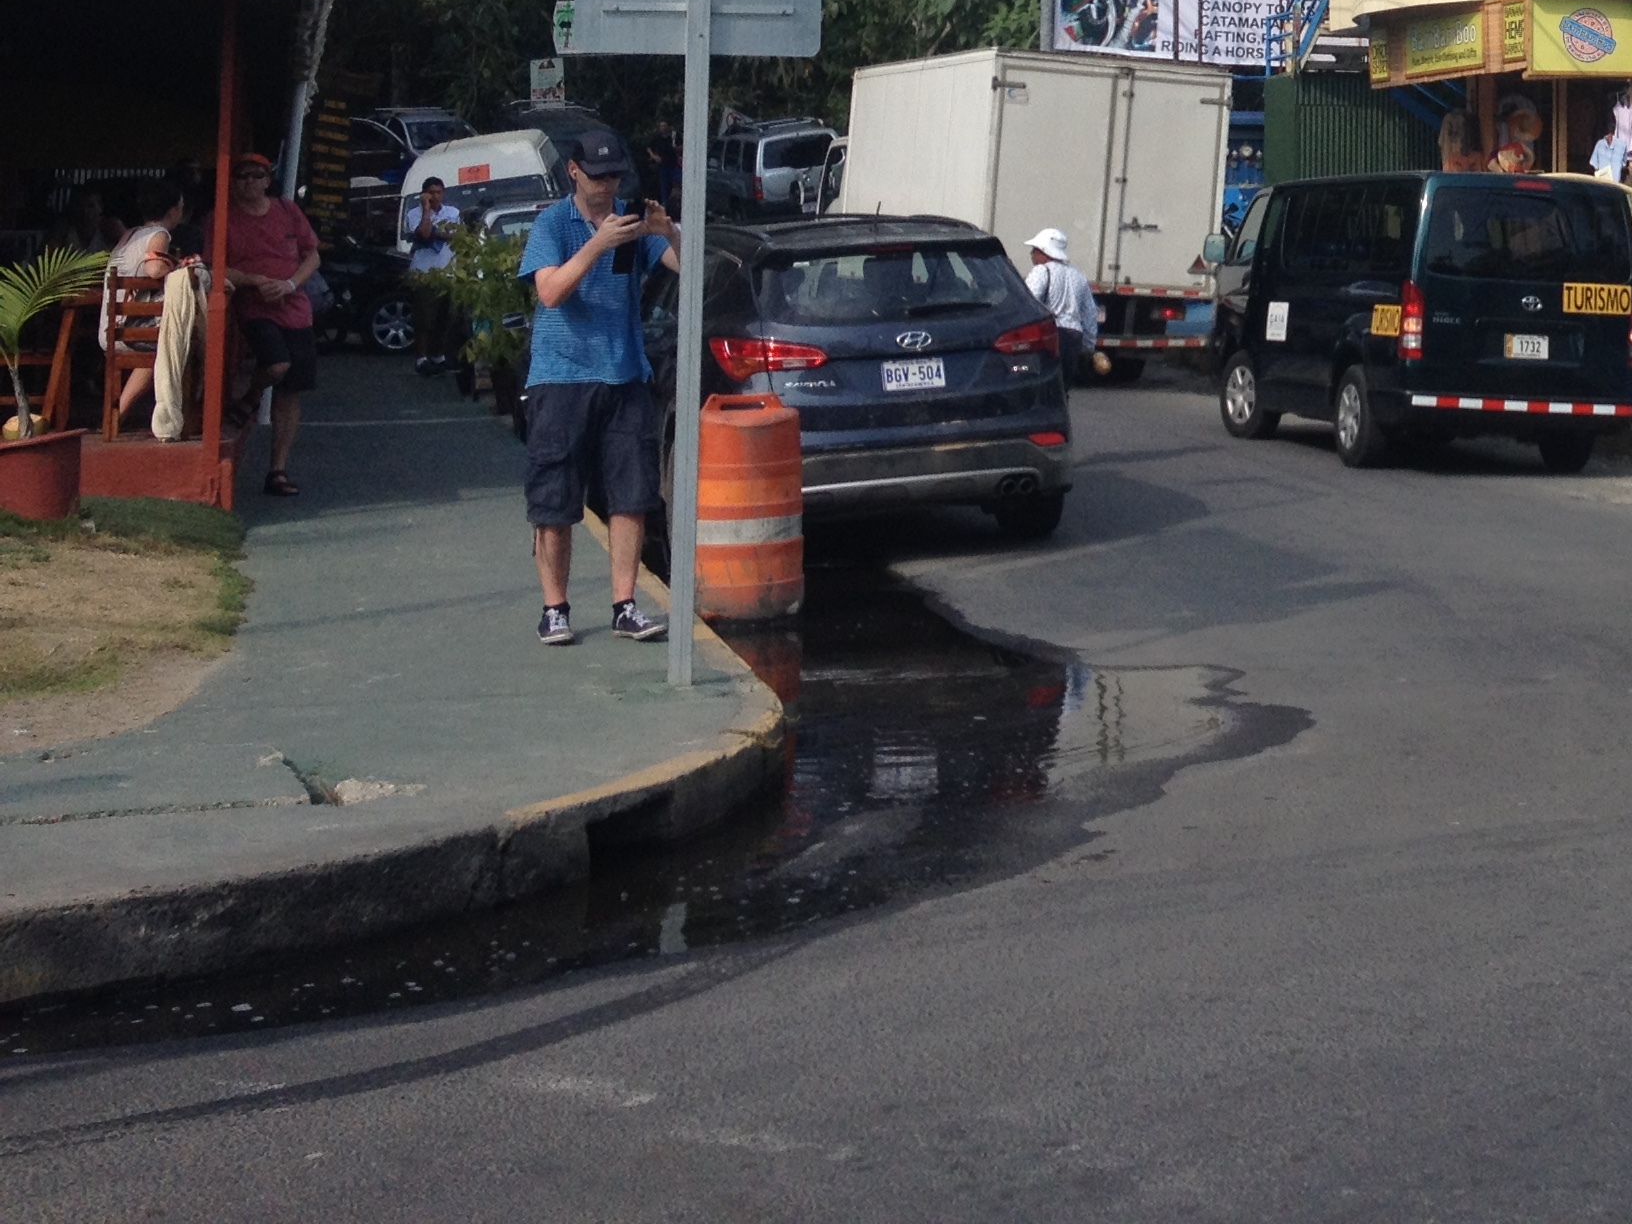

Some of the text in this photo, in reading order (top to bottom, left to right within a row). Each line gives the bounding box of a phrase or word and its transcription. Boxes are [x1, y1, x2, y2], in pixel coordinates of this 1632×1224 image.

[1201, 0, 1262, 15] CANOPY
[1161, 40, 1208, 55] RIDING
[1212, 46, 1221, 57] A
[1226, 46, 1273, 60] HORS
[1565, 285, 1630, 313] TURISMO
[1520, 340, 1541, 353] 1732
[886, 365, 942, 384] BGV-504
